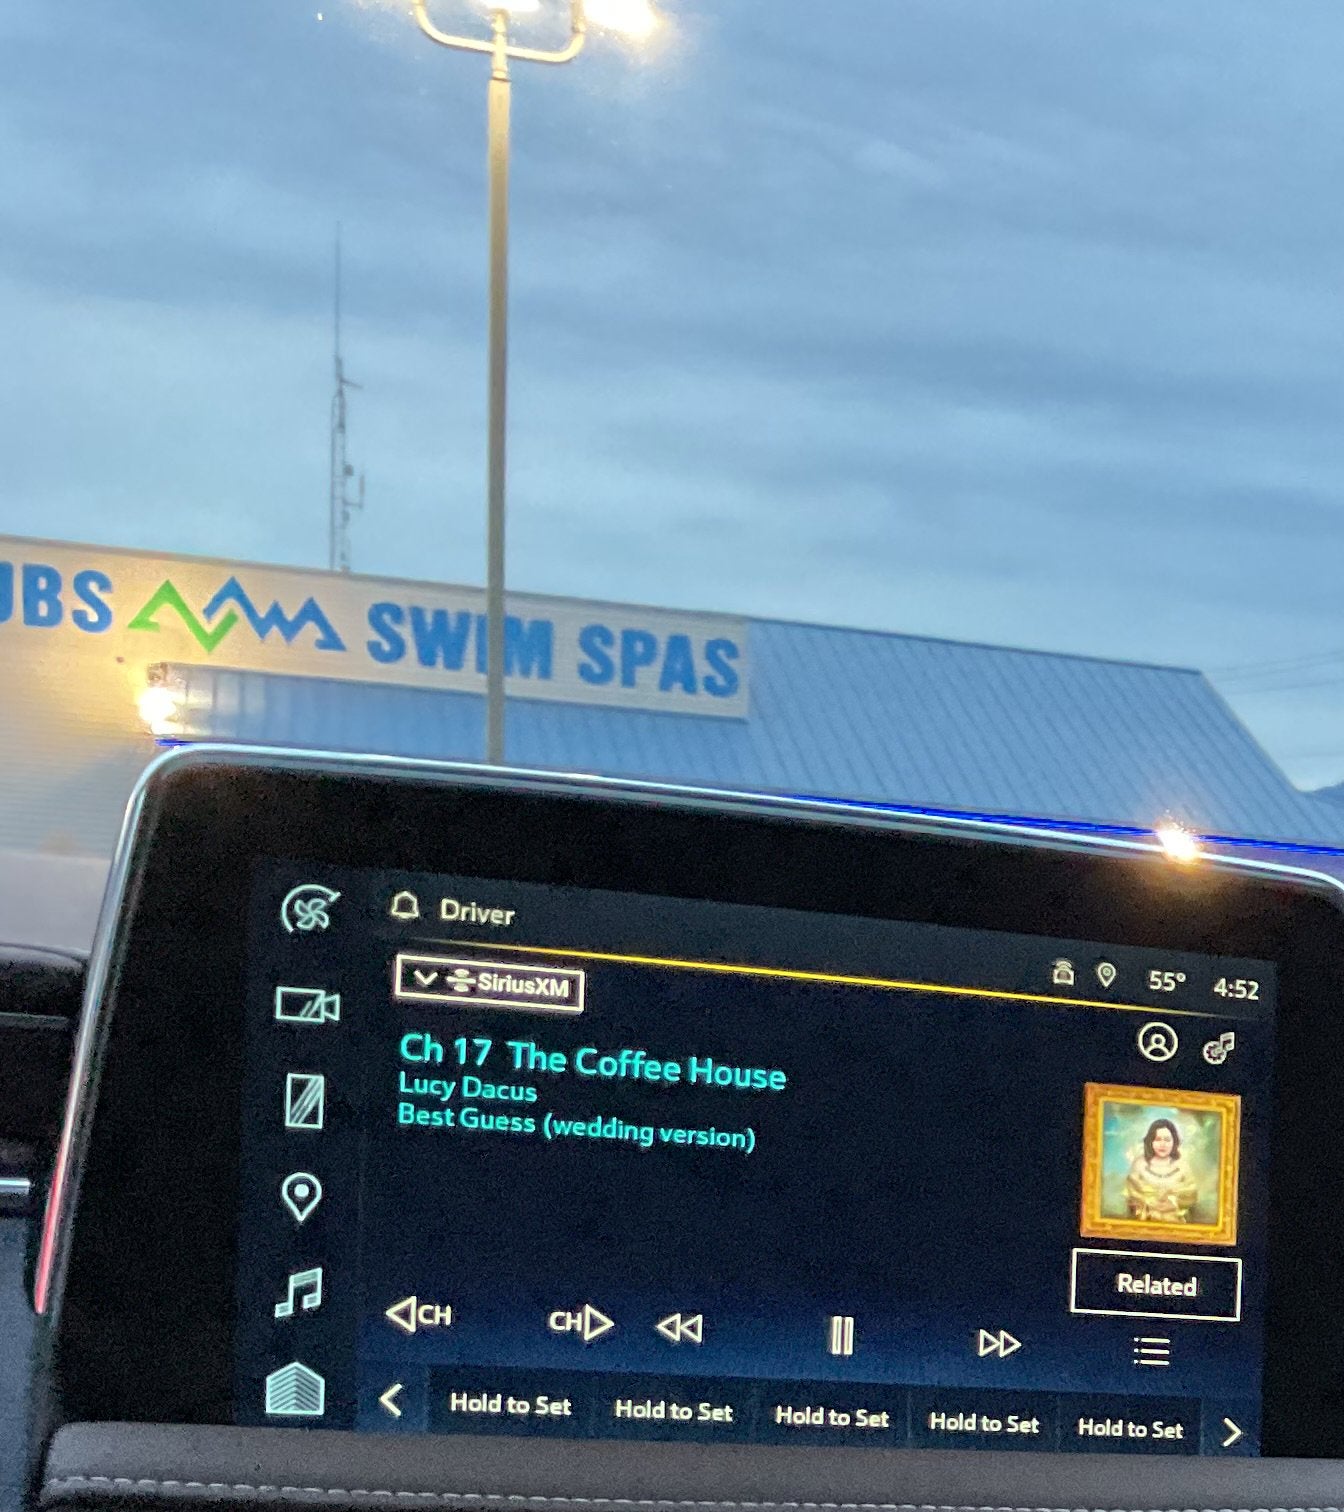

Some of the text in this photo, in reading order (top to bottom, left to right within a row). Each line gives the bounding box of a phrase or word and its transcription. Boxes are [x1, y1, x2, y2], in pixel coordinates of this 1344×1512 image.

[366, 602, 740, 698] SWIM SPAS
[441, 898, 516, 925] Driver
[477, 972, 570, 998] SiriusXM
[1213, 977, 1260, 1001] 4:52
[400, 1032, 787, 1091] Ch 17 The Coffee House
[399, 1070, 538, 1102] Lucy Dacus
[398, 1102, 756, 1154] Best Guess (wedding version)
[1117, 1273, 1198, 1298] Related
[418, 1304, 452, 1325] CH
[549, 1311, 583, 1331] CH
[450, 1392, 572, 1416] Hold to Set
[615, 1400, 734, 1424] Hold to Set
[776, 1405, 890, 1429] Hold to Set
[930, 1412, 1040, 1434] Hold to Set
[1078, 1417, 1184, 1441] Hold to Set
